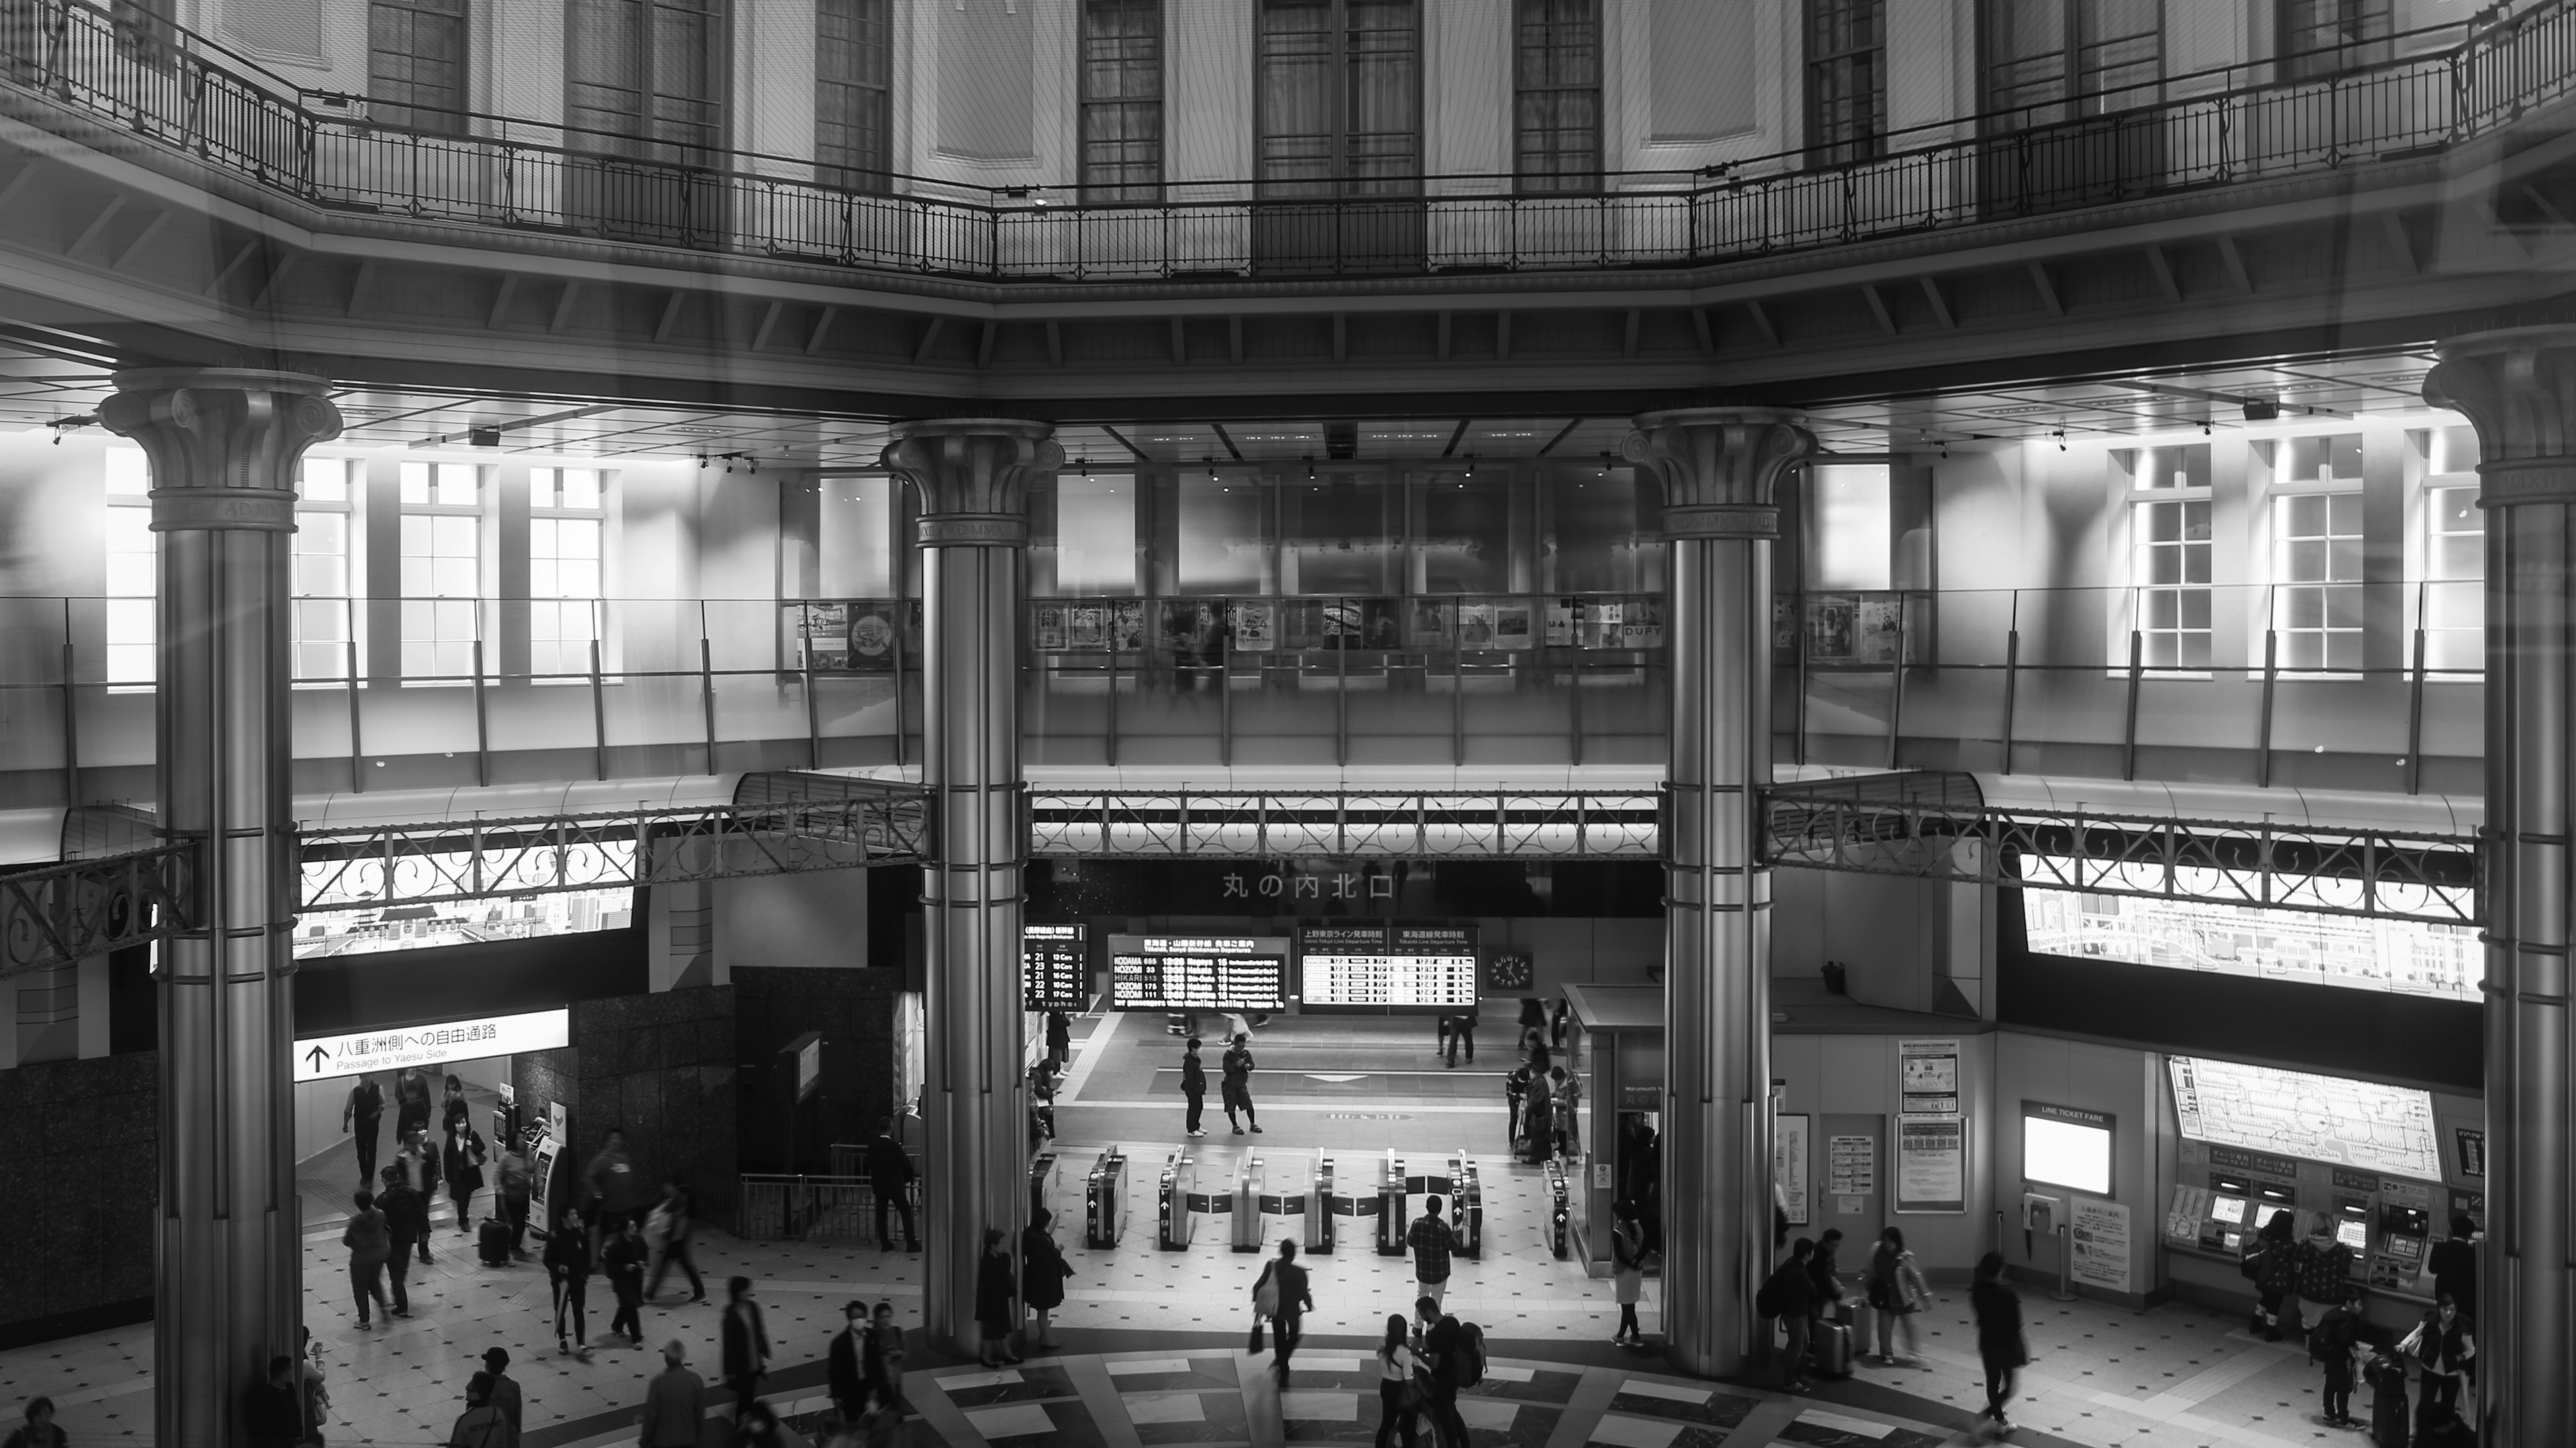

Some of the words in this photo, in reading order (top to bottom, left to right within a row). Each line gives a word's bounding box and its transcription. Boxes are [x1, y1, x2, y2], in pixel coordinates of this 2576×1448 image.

[1625, 627, 1661, 636] DUFY
[1223, 873, 1393, 899] 丸の内北口
[1305, 930, 1383, 938] 上野東京ライン発車時刻
[1034, 952, 1044, 960] 21
[1114, 957, 1142, 965] KODAMA
[1034, 962, 1045, 970] 23
[1060, 962, 1073, 970] Cars
[1114, 966, 1142, 974] NOZOMI
[1034, 971, 1044, 979] 21
[1114, 974, 1142, 983] HIKARI
[1034, 981, 1045, 989] 22
[1114, 983, 1142, 991] NOZOMI
[1163, 983, 1185, 991] 12:40
[1034, 990, 1045, 998] 22
[1114, 991, 1142, 999] NOZOMI
[1217, 1000, 1244, 1008] rolling
[1246, 1000, 1275, 1008] luggage
[337, 1024, 496, 1058] 八重洲側への自由通路
[337, 1058, 379, 1071] Passage
[382, 1056, 391, 1064] to
[394, 1052, 423, 1063] Yaesu
[426, 1049, 447, 1059] Side
[2041, 1106, 2057, 1115] LINE
[2059, 1109, 2083, 1119] TICKET
[2084, 1113, 2104, 1122] FARE
[2213, 1150, 2249, 1162] チャージ専用
[2256, 1158, 2293, 1169] チャージ専用
